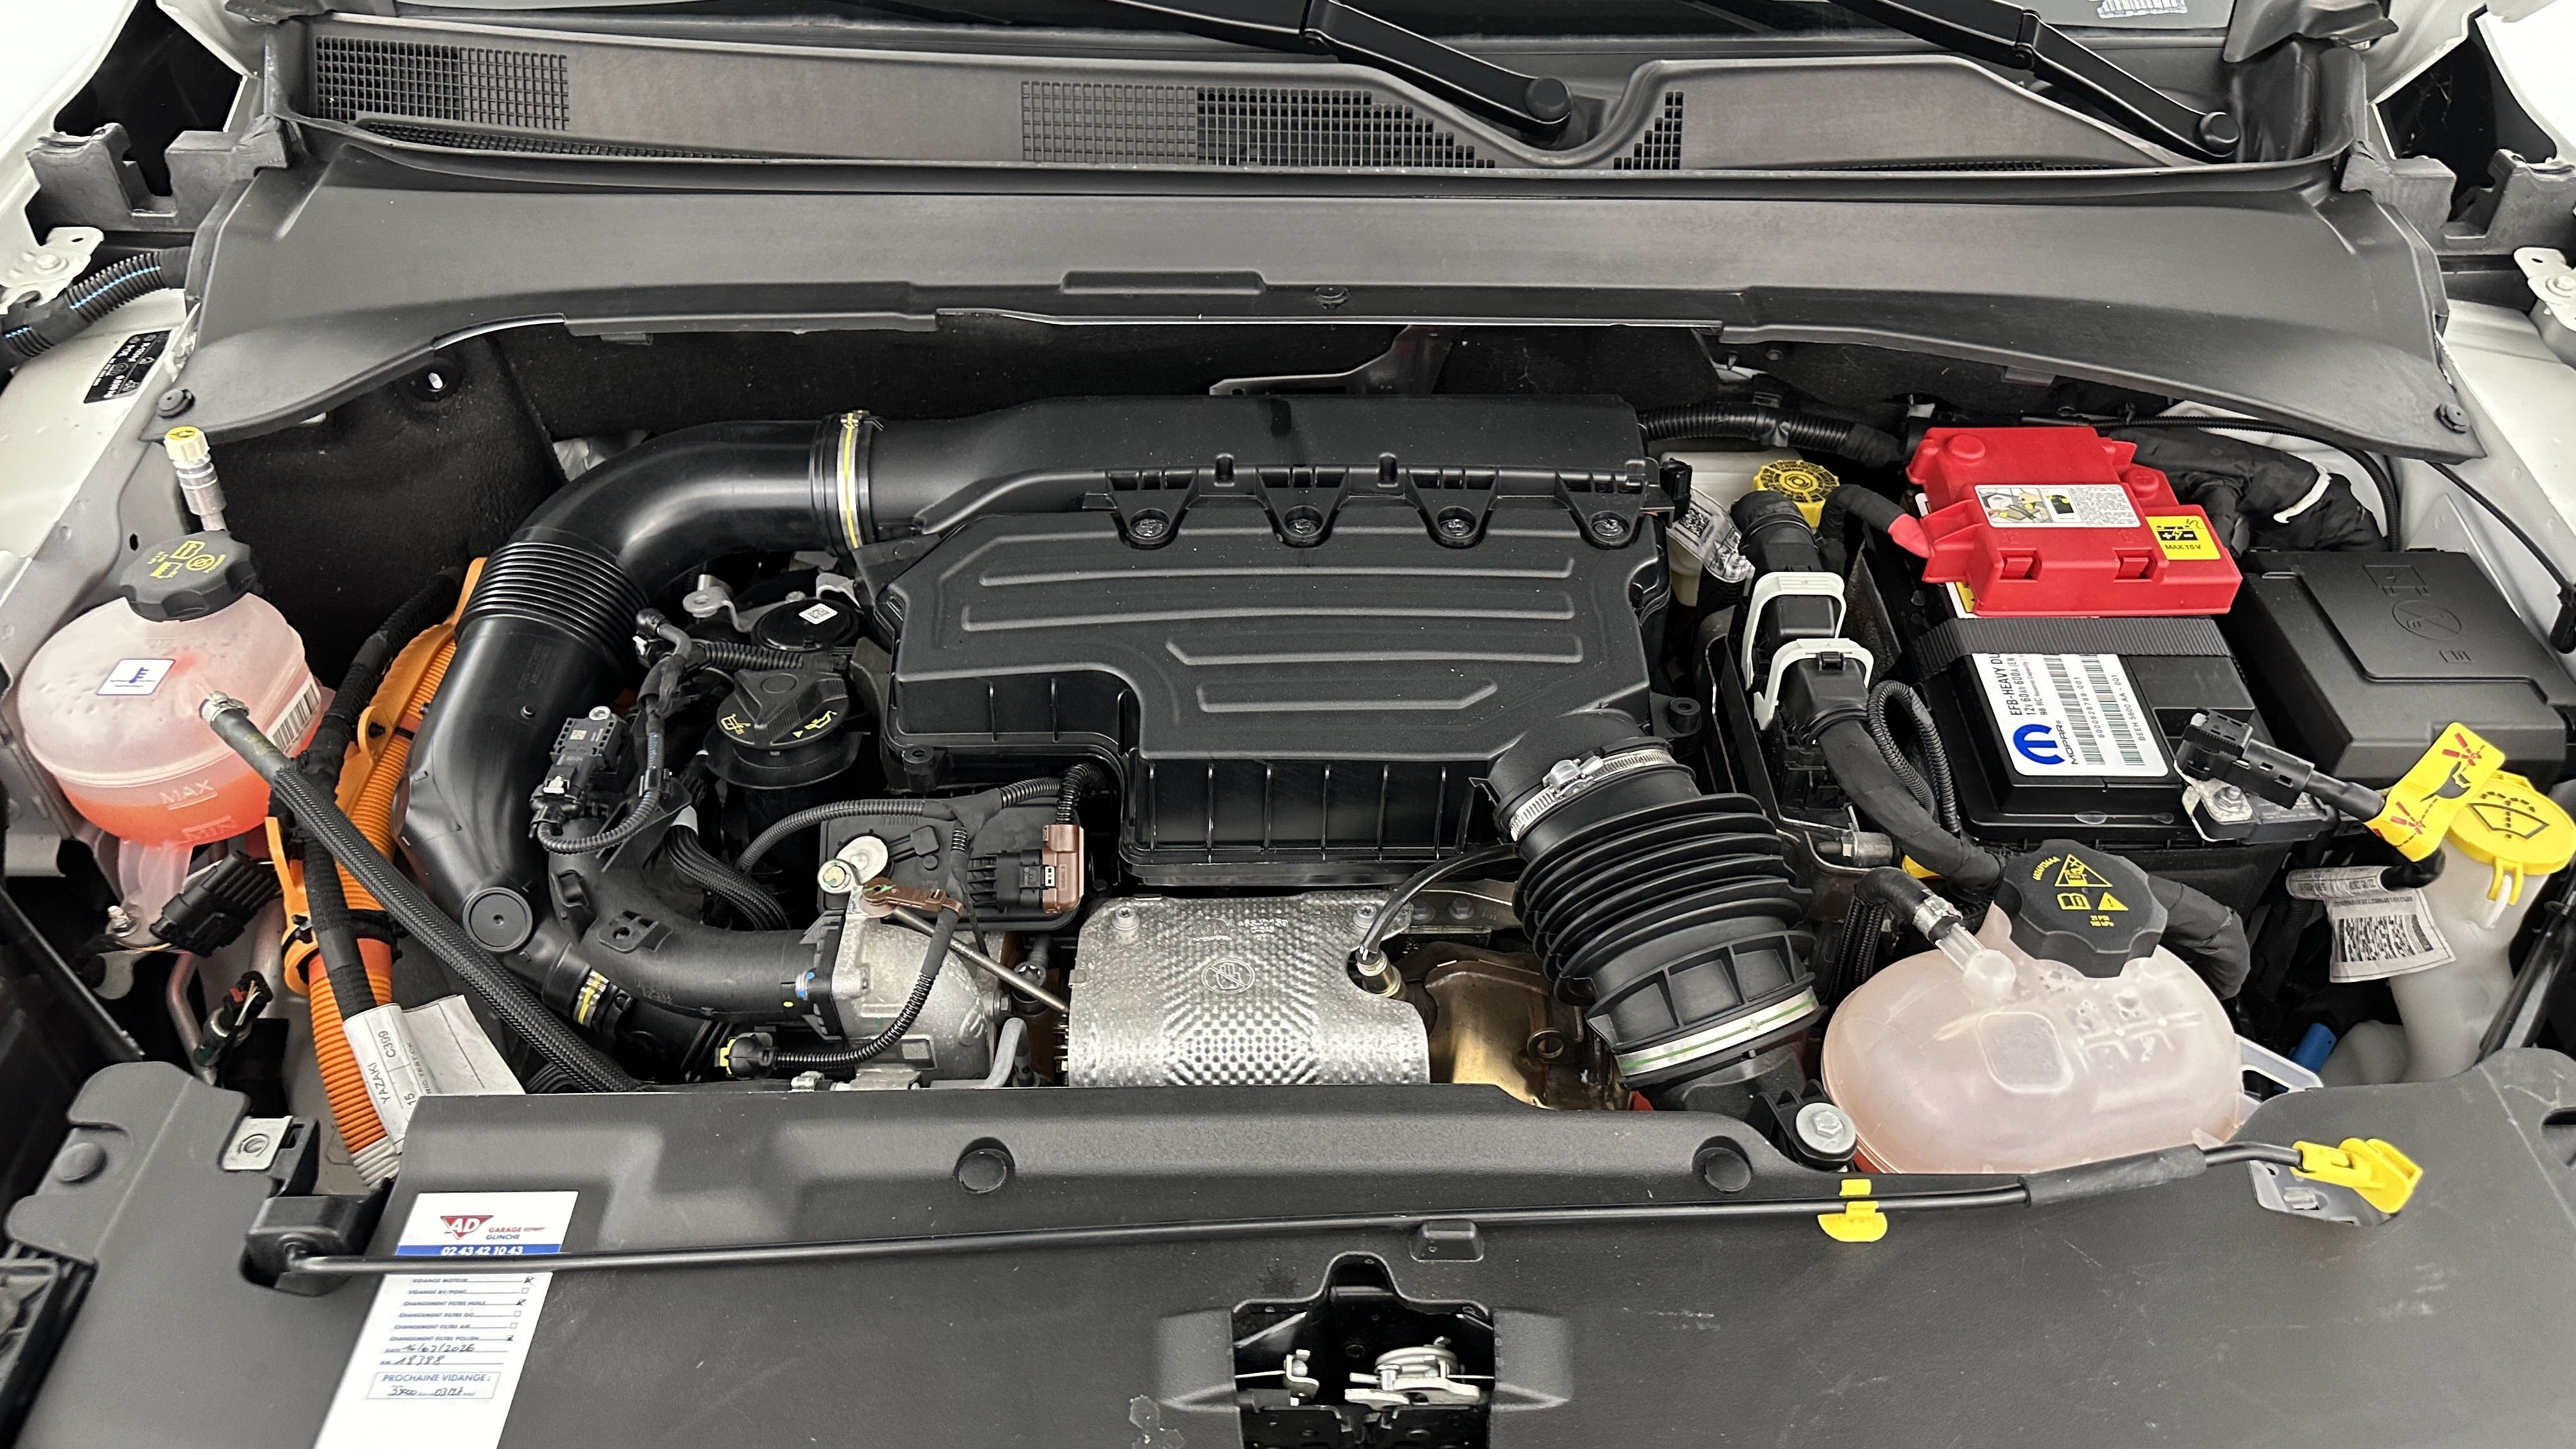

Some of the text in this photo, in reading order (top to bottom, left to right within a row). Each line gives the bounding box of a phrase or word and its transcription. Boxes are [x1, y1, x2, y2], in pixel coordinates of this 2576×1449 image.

[2011, 668, 2025, 684] 600A
[1993, 667, 2023, 715] EFB-HEAVY
[2018, 686, 2032, 702] 60Ah
[2034, 698, 2044, 706] RC
[160, 779, 213, 804] MAX
[378, 1030, 395, 1058] C399
[367, 1062, 390, 1105] YAZAKI
[447, 1217, 481, 1233] AD
[441, 1246, 524, 1256] 02 43 42 10 43
